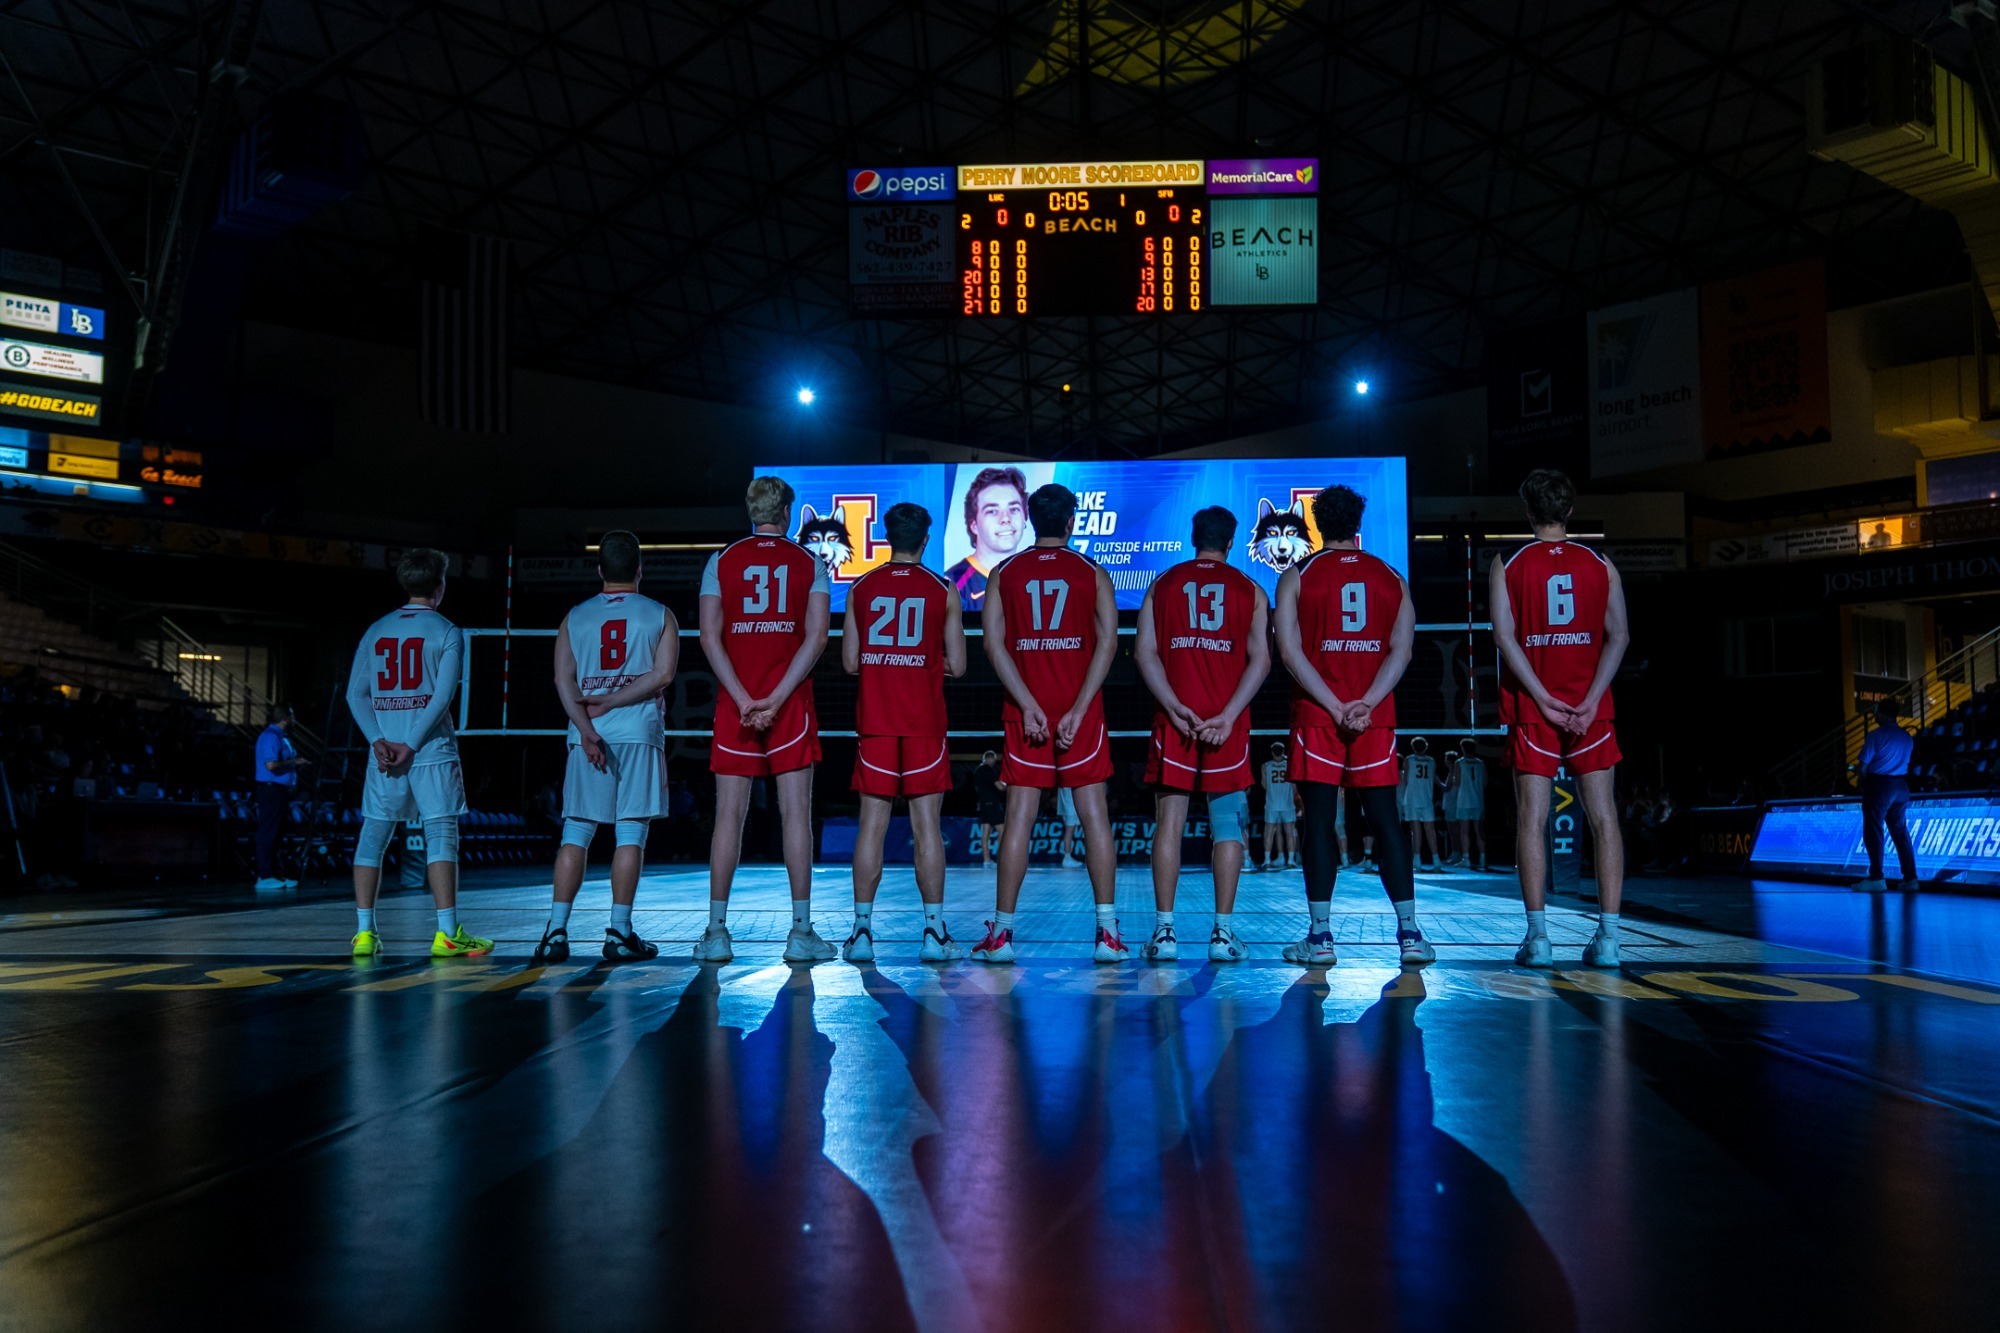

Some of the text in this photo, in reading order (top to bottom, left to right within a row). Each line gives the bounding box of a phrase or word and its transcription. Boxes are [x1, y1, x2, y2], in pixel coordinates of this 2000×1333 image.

[962, 163, 1200, 186] PERRY MOORE SCOREBOARD
[1212, 171, 1294, 184] MemorialCare
[886, 172, 946, 196] pepsi
[1049, 191, 1090, 212] 0:05
[863, 206, 941, 231] NAPLES
[961, 208, 1036, 230] 2 0 0
[1135, 204, 1202, 226] 0 0 2
[885, 225, 922, 242] RIB
[1044, 217, 1118, 235] BEACH
[1144, 236, 1200, 251] 6 0 0
[1212, 227, 1313, 248] BEACH
[865, 235, 942, 259] COMPANY
[971, 240, 1026, 255] 8 0 0
[972, 254, 1026, 270] 9 0 0
[1145, 251, 1200, 266] 9 0 0
[964, 270, 1026, 285] 20 0 0
[1141, 266, 1200, 281] 13 0 0
[964, 285, 983, 299] 21
[990, 284, 1000, 298] 0
[1016, 284, 1026, 298] 0
[1141, 281, 1200, 296] 17 0 0
[6, 299, 50, 314] PENTA
[964, 299, 983, 315] 27
[990, 300, 1000, 314] 0
[1016, 299, 1026, 313] 0
[1136, 296, 1200, 312] 20 0 0
[0, 390, 97, 418] #GOBEACH
[1599, 385, 1692, 417] long beach
[1521, 419, 1548, 433] LONG
[1550, 412, 1584, 427] BEACH
[1599, 415, 1650, 438] airport
[1073, 491, 1107, 510] AKE
[1072, 511, 1117, 536] EAD
[1829, 528, 1848, 536] most
[1093, 541, 1182, 553] OUTSIDE HITTER
[742, 564, 788, 614] 31
[1824, 564, 1915, 600] JOSEPH
[1025, 578, 1070, 631] 17
[1182, 581, 1225, 632] 13
[1340, 582, 1366, 632] 9
[1546, 573, 1575, 626] 6
[754, 621, 795, 633] FRANCIS
[868, 596, 926, 647] 20
[601, 619, 627, 670] 8
[1041, 636, 1081, 650] FRANCIS
[1170, 637, 1232, 652] SAINT FRANCIS
[1320, 640, 1343, 652] SAINT
[1525, 631, 1592, 647] SAINT FRANCIS
[375, 637, 425, 691] 30
[884, 653, 925, 667] FRANCIS
[1416, 764, 1429, 779] 31
[1470, 767, 1476, 780] 1
[1700, 832, 1715, 854] GO
